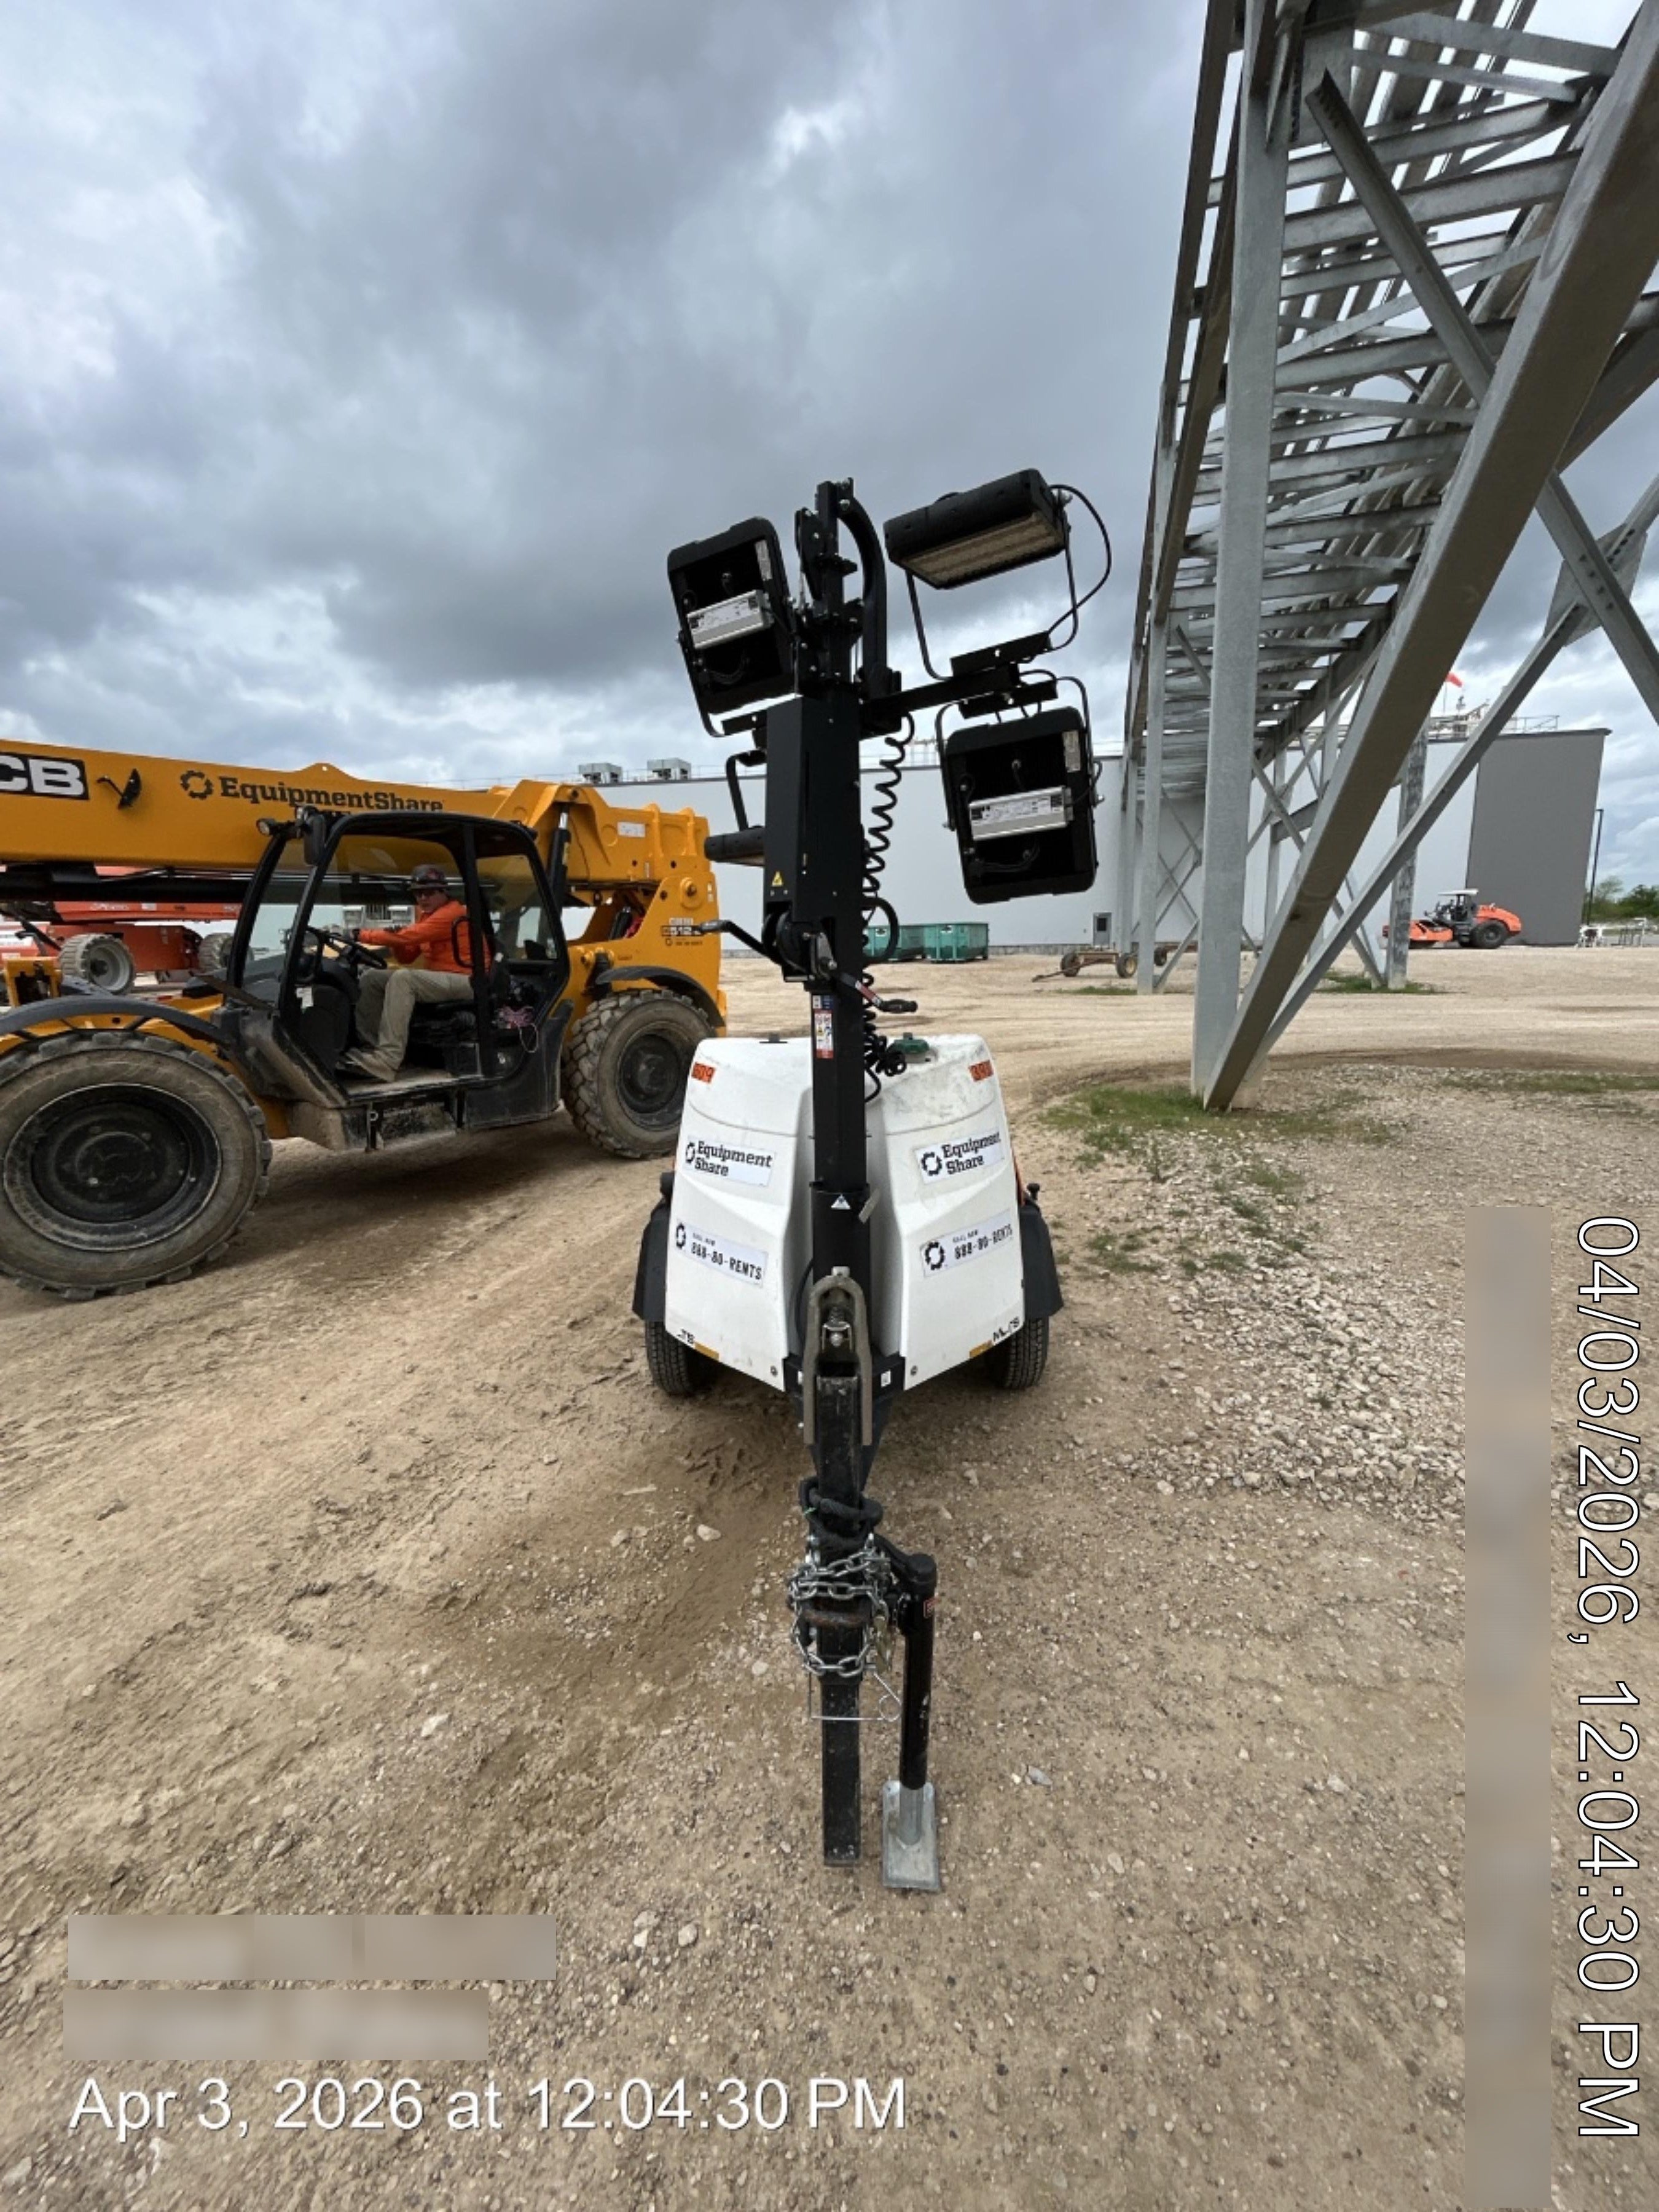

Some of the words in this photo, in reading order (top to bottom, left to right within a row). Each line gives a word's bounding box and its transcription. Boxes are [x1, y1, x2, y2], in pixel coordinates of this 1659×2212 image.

[219, 775, 443, 812] EquipmentShare
[697, 1140, 773, 1167] Equipment
[941, 1131, 1002, 1158] Equipment
[694, 1156, 729, 1177] Share
[946, 1155, 984, 1175] Share
